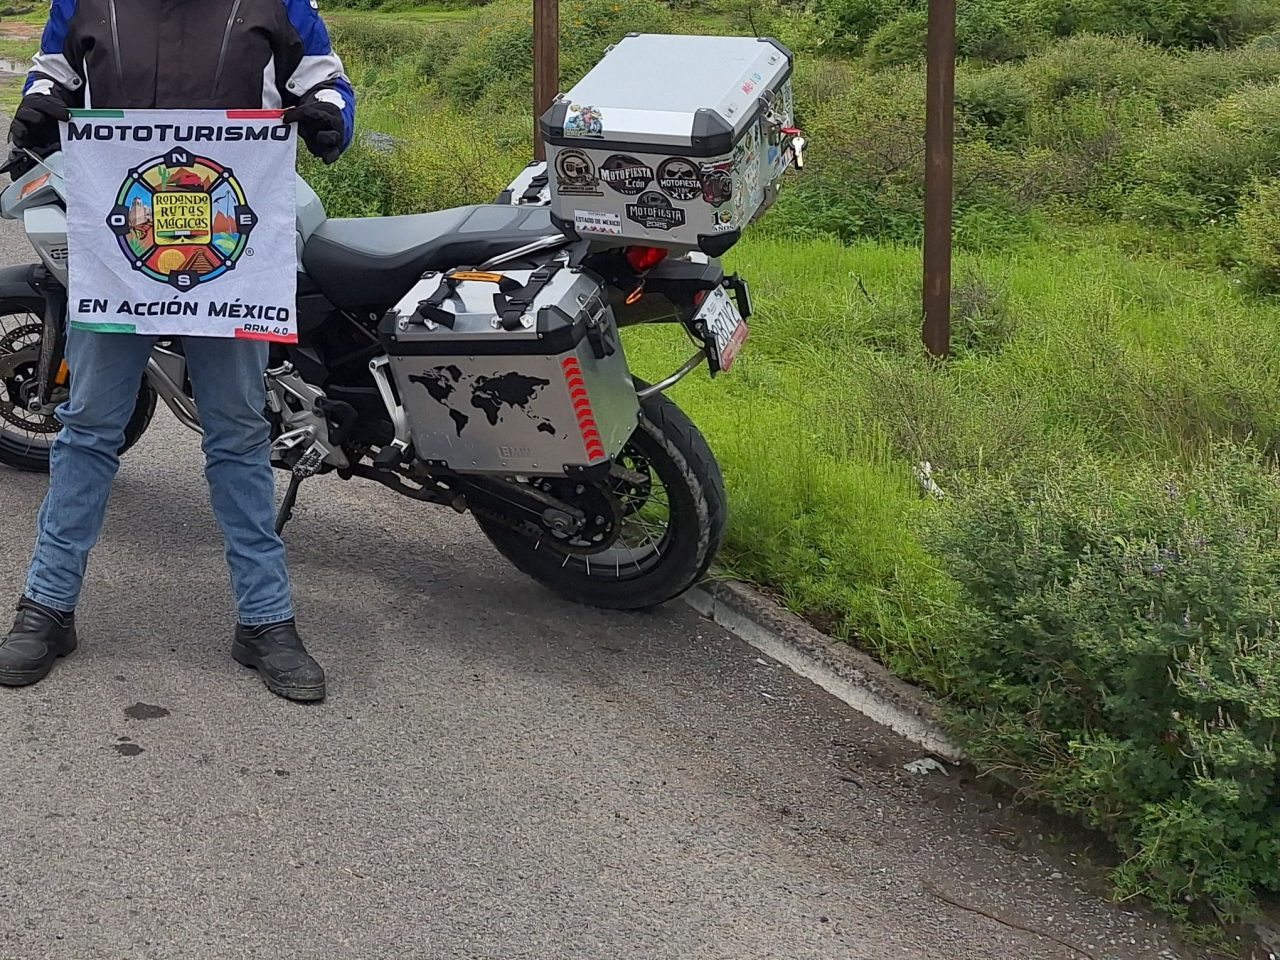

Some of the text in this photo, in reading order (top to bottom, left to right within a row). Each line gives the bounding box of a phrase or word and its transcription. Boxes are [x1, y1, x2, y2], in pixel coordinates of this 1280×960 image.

[67, 123, 291, 142] MOTOTURISMO
[171, 153, 187, 163] N
[601, 167, 652, 182] MOTOFIESTA
[660, 179, 701, 189] MOTOFIESTA
[671, 191, 695, 200] XIX
[630, 205, 682, 221] MOTOFIESTA
[110, 215, 126, 226] O
[239, 214, 252, 225] E
[177, 274, 191, 286] S
[77, 295, 290, 322] EN ACCIÓN MÉXICO
[243, 323, 289, 336] RRM 4.0
